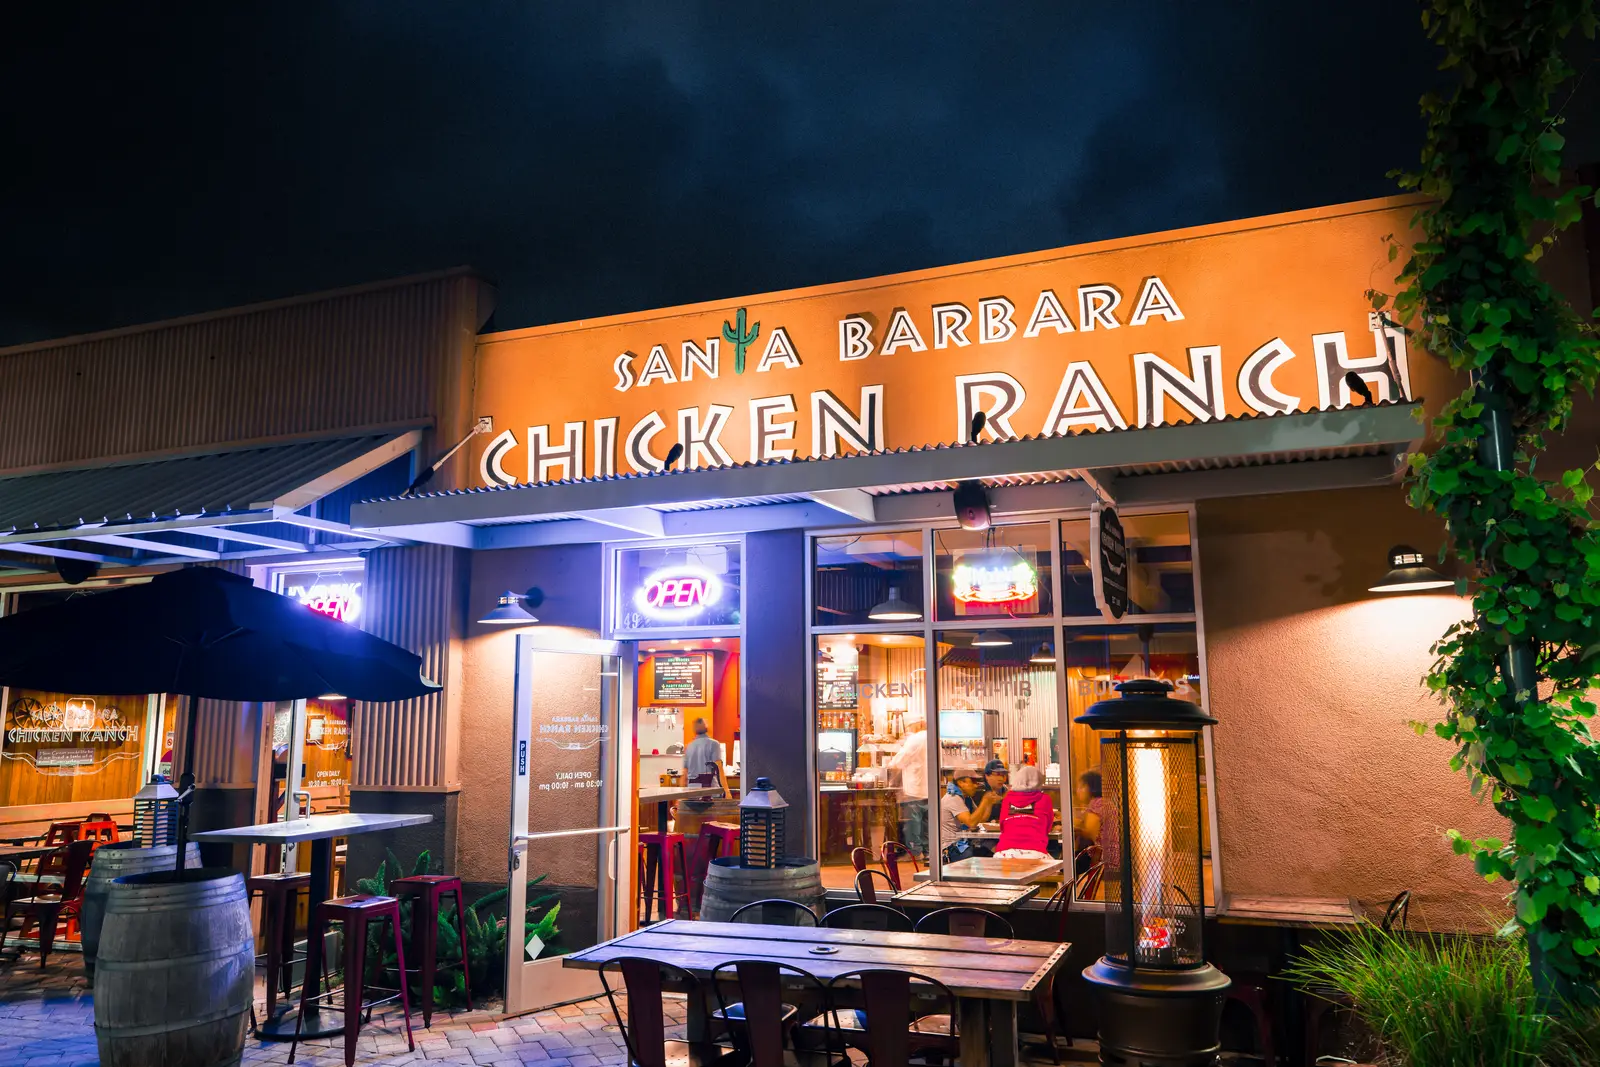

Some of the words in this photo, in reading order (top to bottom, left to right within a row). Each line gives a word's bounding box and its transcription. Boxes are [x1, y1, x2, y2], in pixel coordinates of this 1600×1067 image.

[614, 308, 801, 392] SANTA
[838, 276, 1185, 361] BARBARA
[480, 385, 884, 487] CHICKEN
[955, 326, 1412, 444] RANCH
[646, 579, 711, 607] OPEN
[831, 683, 913, 698] CHICKEN
[8, 727, 74, 743] CHICKEN
[80, 725, 139, 742] RANCH
